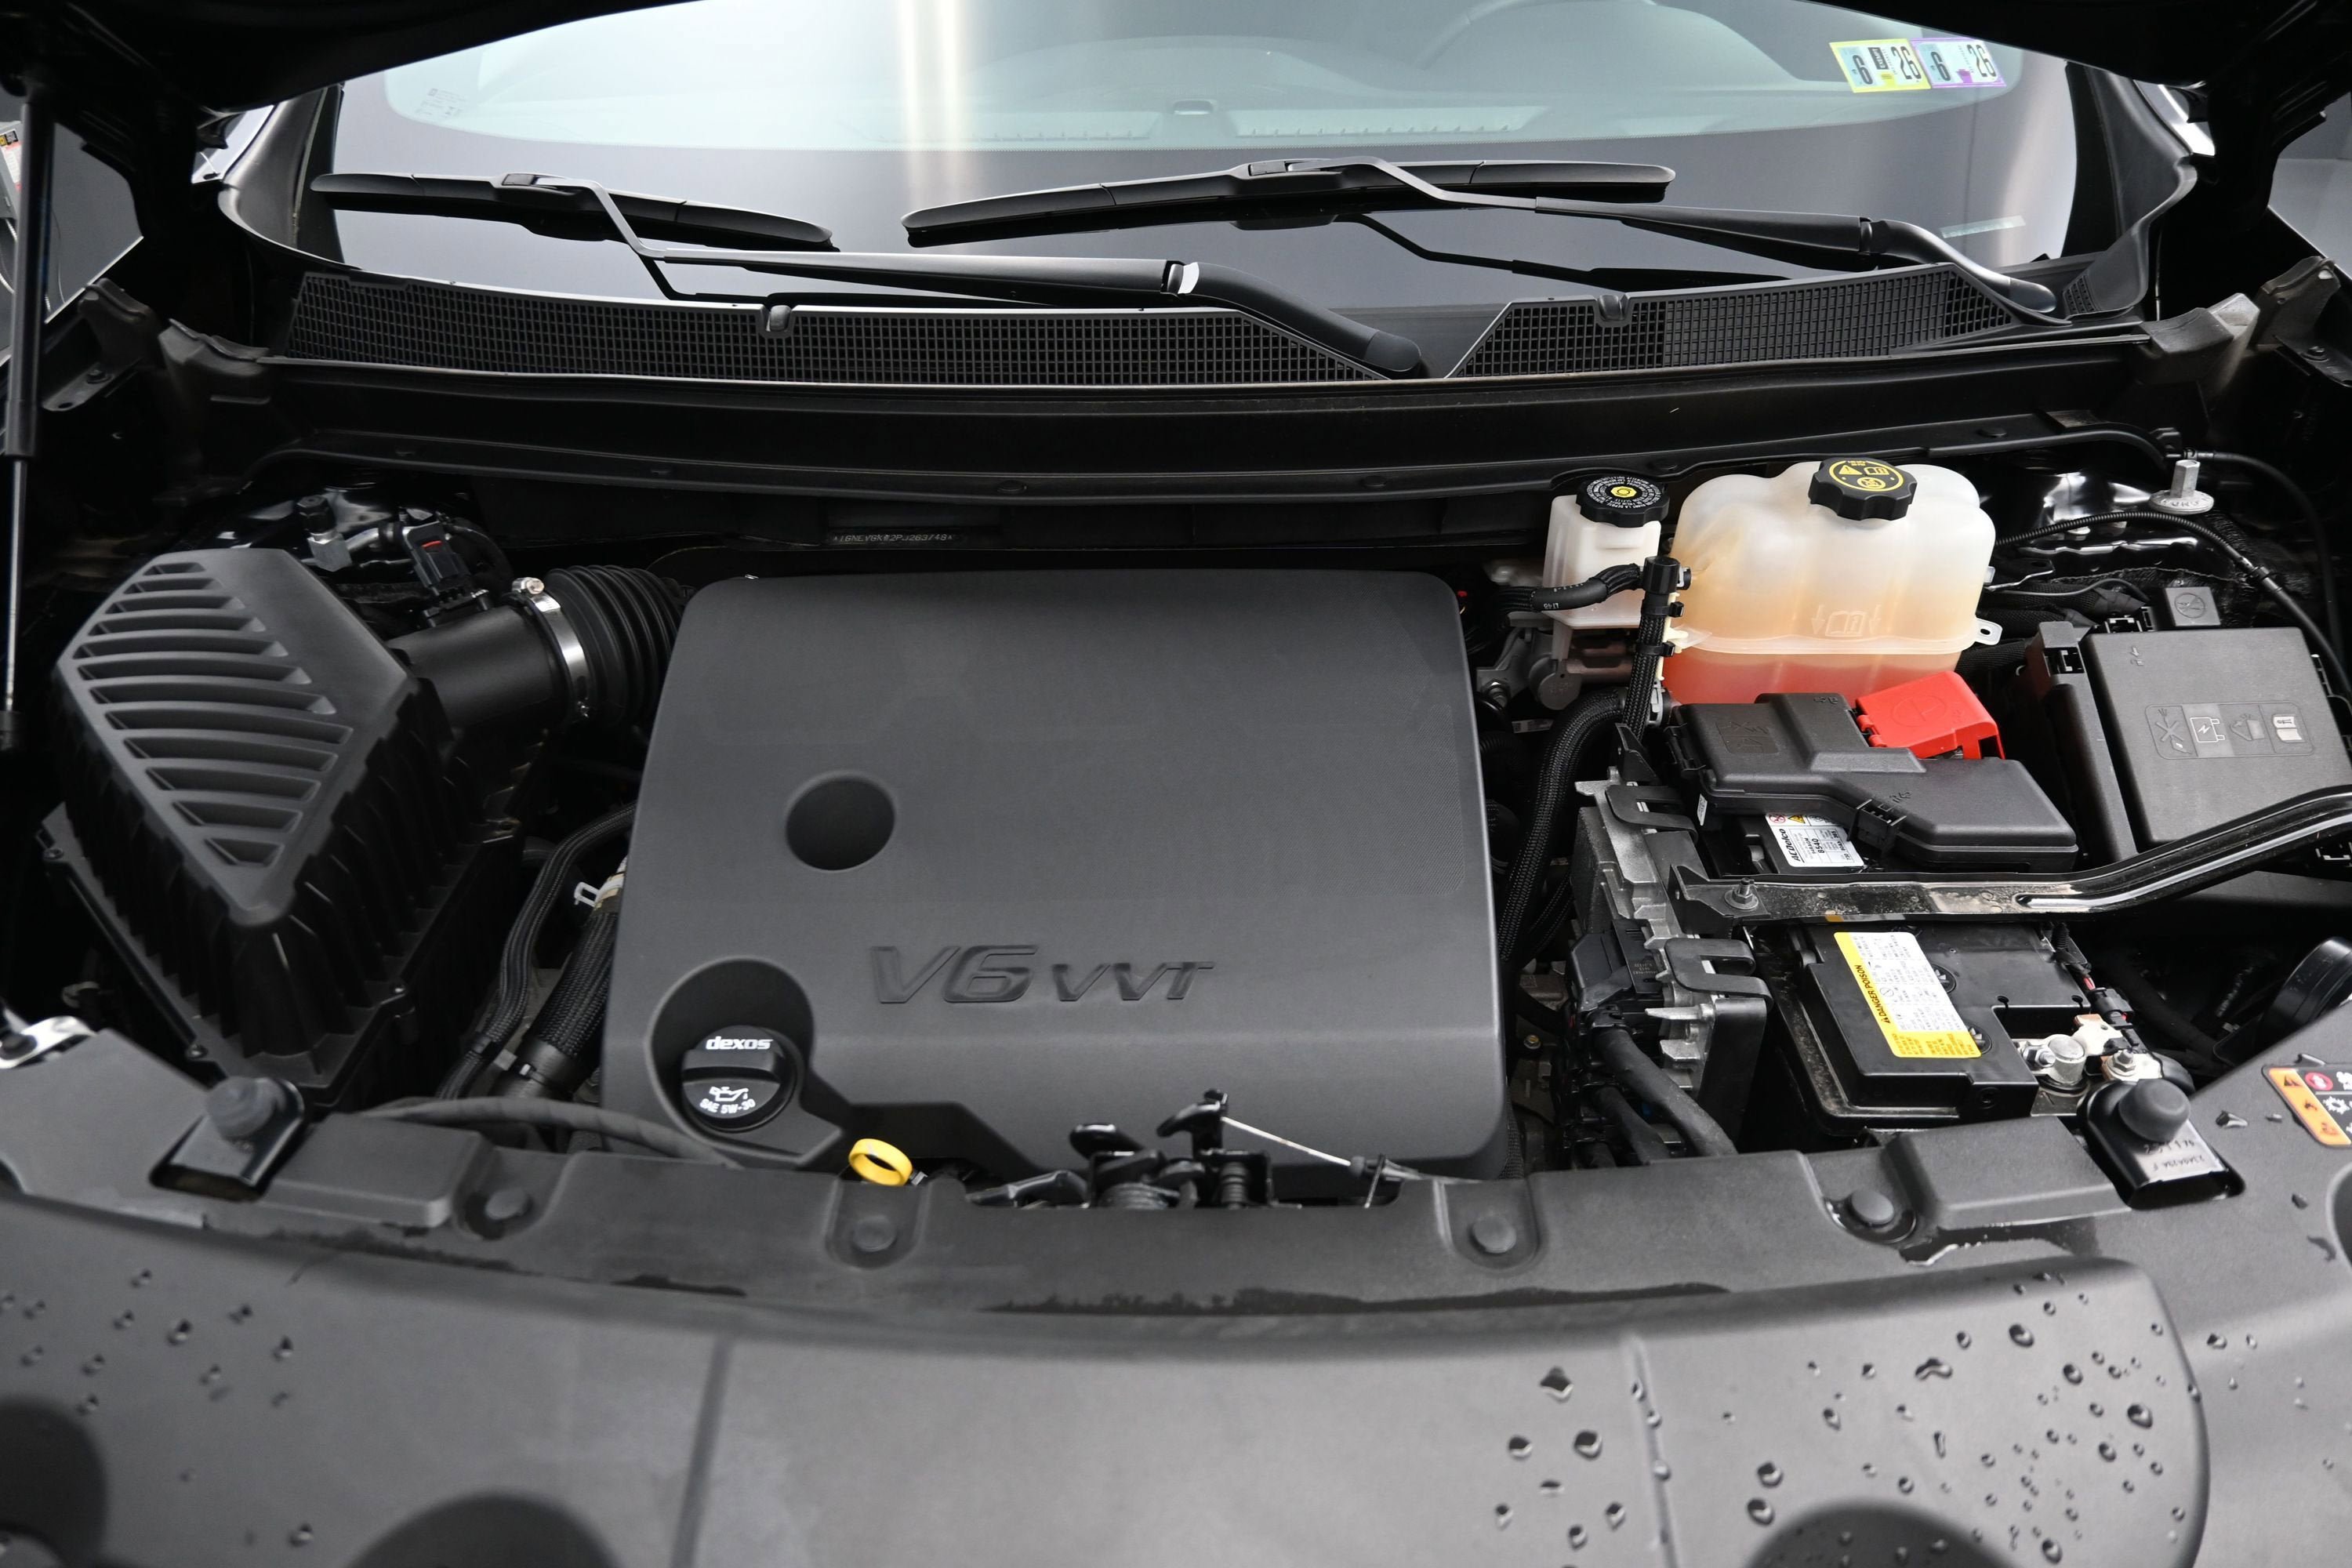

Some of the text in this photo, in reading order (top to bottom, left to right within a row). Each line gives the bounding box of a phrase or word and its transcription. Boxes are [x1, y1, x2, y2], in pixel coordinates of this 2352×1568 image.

[1853, 55, 1873, 85] 6
[1891, 46, 1921, 80] 26
[1930, 51, 1951, 82] 6
[1967, 44, 1998, 78] 26
[1779, 828, 1801, 862] ACDelco
[1811, 838, 1825, 854] 8540
[871, 945, 1214, 1004] V6 VVT
[706, 1036, 774, 1050] dexos
[699, 1098, 756, 1113] SAE 5W-30
